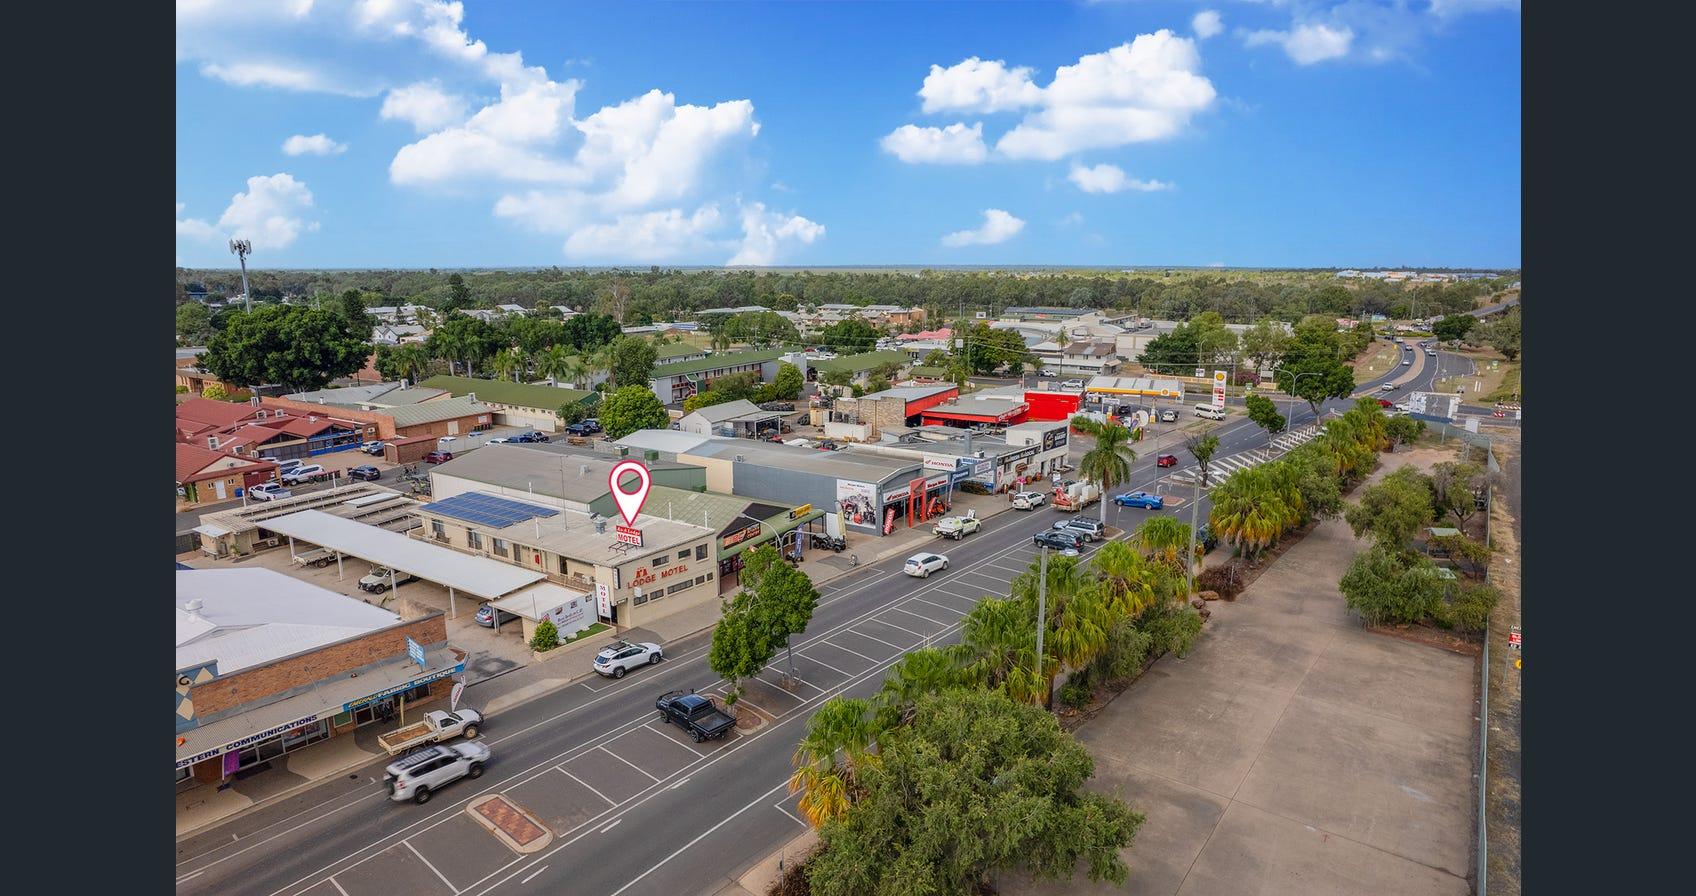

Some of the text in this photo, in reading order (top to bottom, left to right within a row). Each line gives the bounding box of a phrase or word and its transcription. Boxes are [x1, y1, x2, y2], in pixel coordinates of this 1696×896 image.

[931, 460, 954, 468] HONDA
[891, 491, 909, 499] HONDA
[885, 511, 894, 534] HONDA
[617, 533, 640, 545] MOTEL
[627, 574, 656, 589] LODGE
[661, 564, 688, 578] MOTEL
[414, 667, 456, 685] BOUTIQUE
[176, 714, 318, 767] ESTERN COMMUNICATIONS
